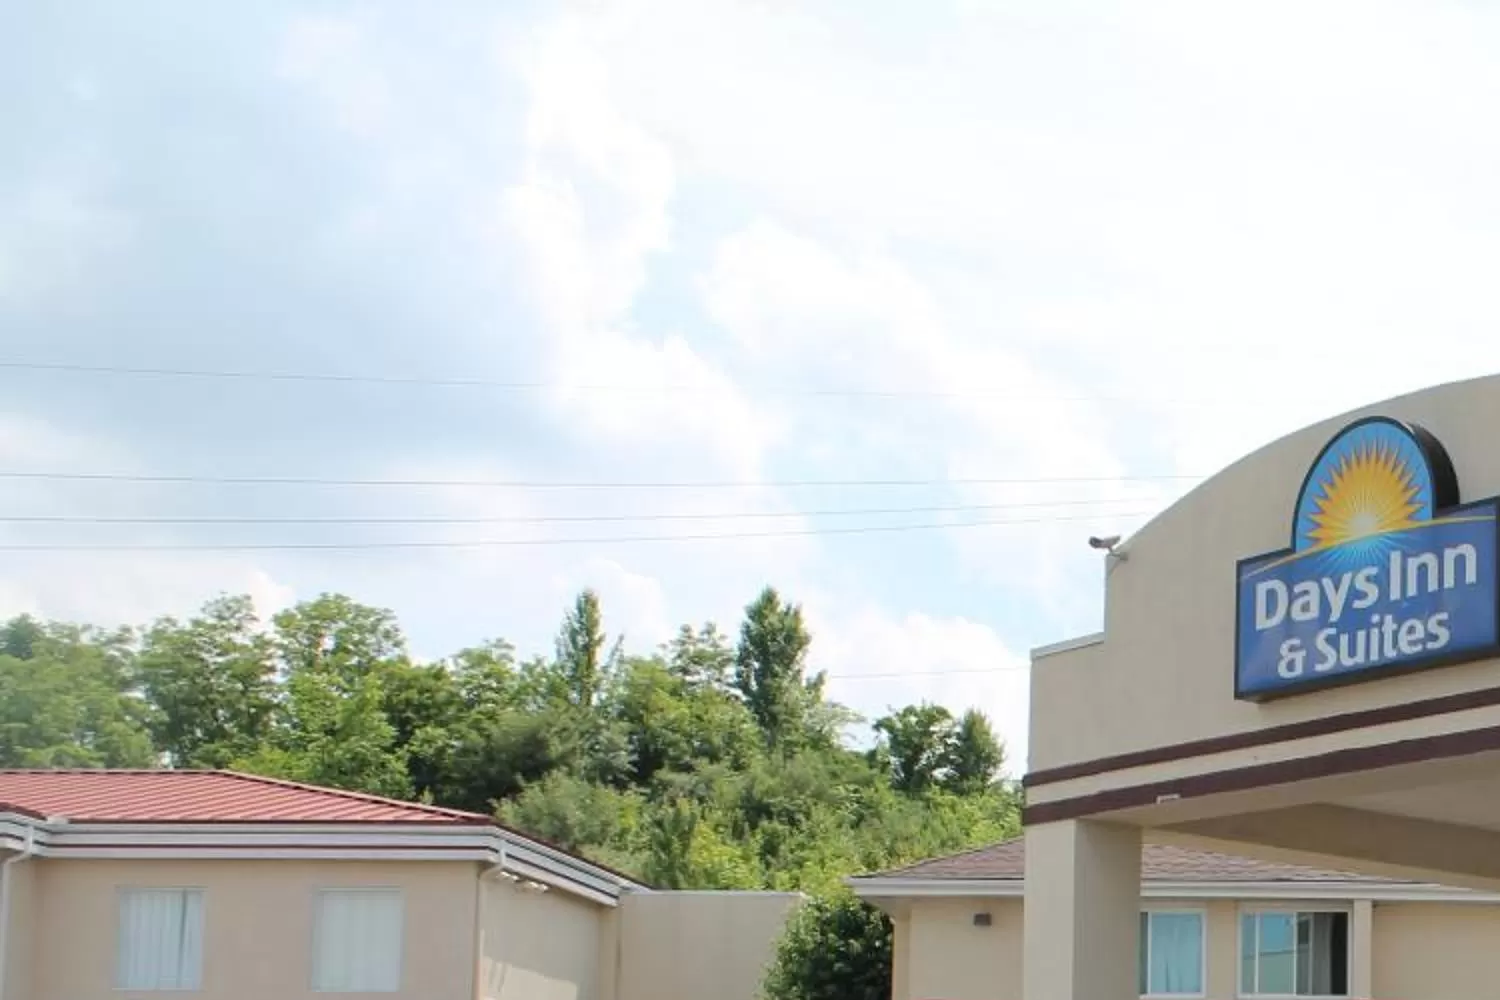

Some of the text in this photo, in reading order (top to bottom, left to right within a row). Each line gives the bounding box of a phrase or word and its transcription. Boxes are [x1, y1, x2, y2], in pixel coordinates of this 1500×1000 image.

[1255, 543, 1477, 631] Days Inn
[1276, 611, 1451, 680] & Suites
